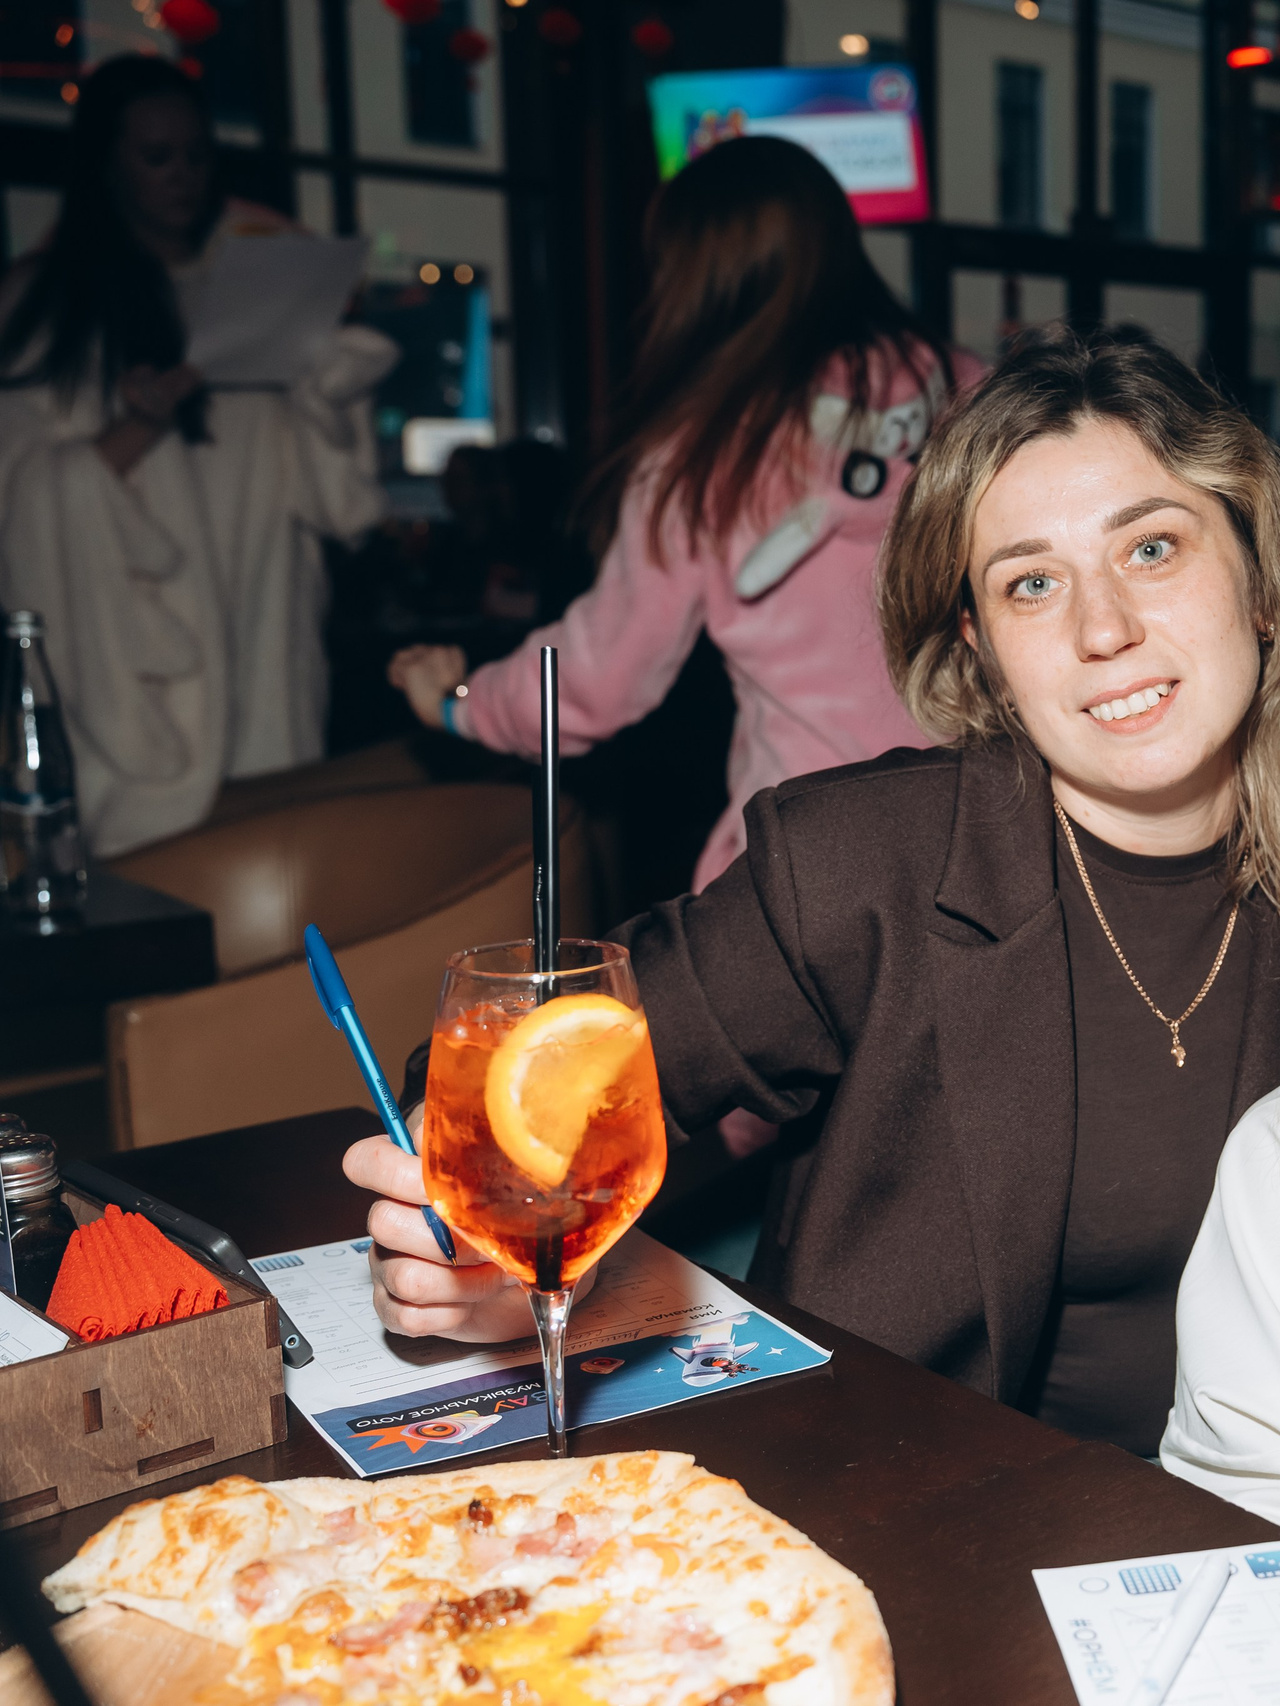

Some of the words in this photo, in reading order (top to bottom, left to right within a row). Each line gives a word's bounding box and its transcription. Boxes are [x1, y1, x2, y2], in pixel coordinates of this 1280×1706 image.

[376, 1078, 400, 1121] ErichKrause
[644, 1303, 715, 1322] Команда
[689, 1309, 723, 1321] Имя
[409, 1382, 541, 1419] МУЗЫКАЛЬНОЕ
[356, 1414, 404, 1428] ЛОТО
